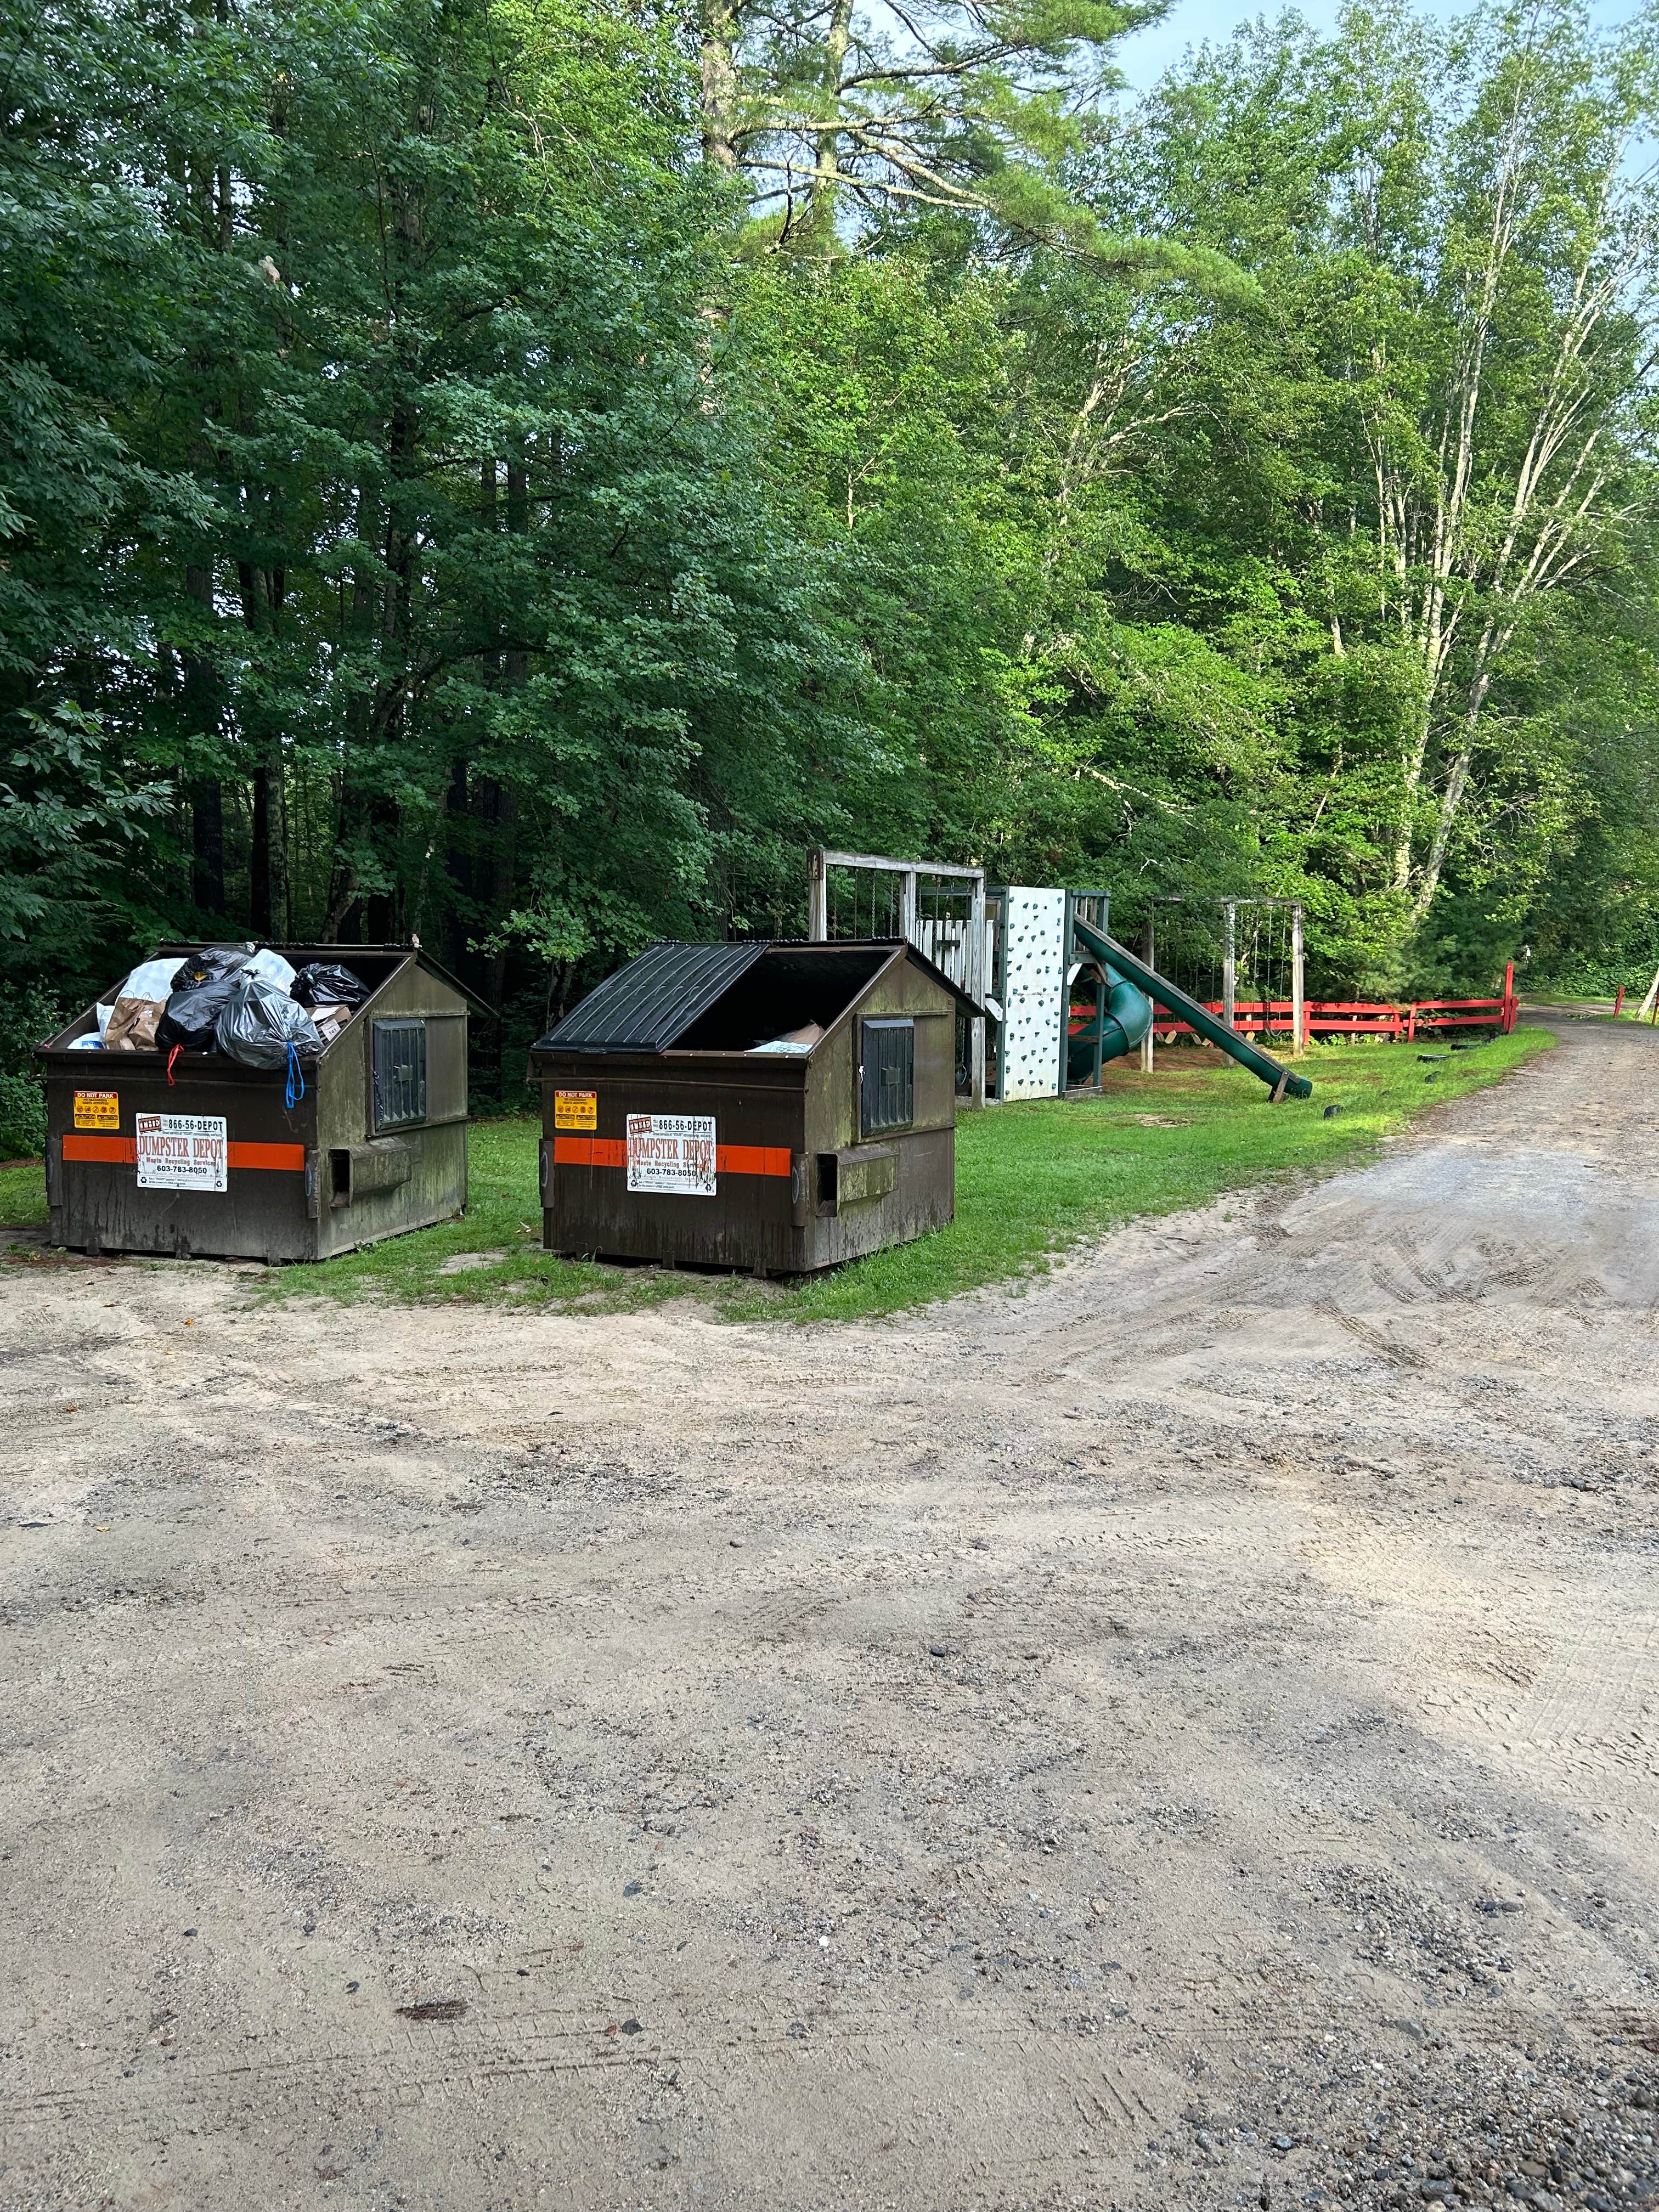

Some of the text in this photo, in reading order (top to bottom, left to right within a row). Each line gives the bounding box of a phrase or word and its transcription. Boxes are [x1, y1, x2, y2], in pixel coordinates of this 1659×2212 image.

[140, 1119, 160, 1129] THE
[169, 1119, 223, 1131] 866-56-DEPOT
[631, 1120, 650, 1131] THE
[659, 1120, 712, 1131] 866-56-DEPOT
[139, 1136, 223, 1159] DUMPSTER DEPOT
[629, 1137, 712, 1160] DUMPSTER DEPOT
[157, 1165, 207, 1174] 603-783-8050
[655, 1160, 679, 1169] Recycling
[647, 1168, 696, 1176] 603-783-8050
